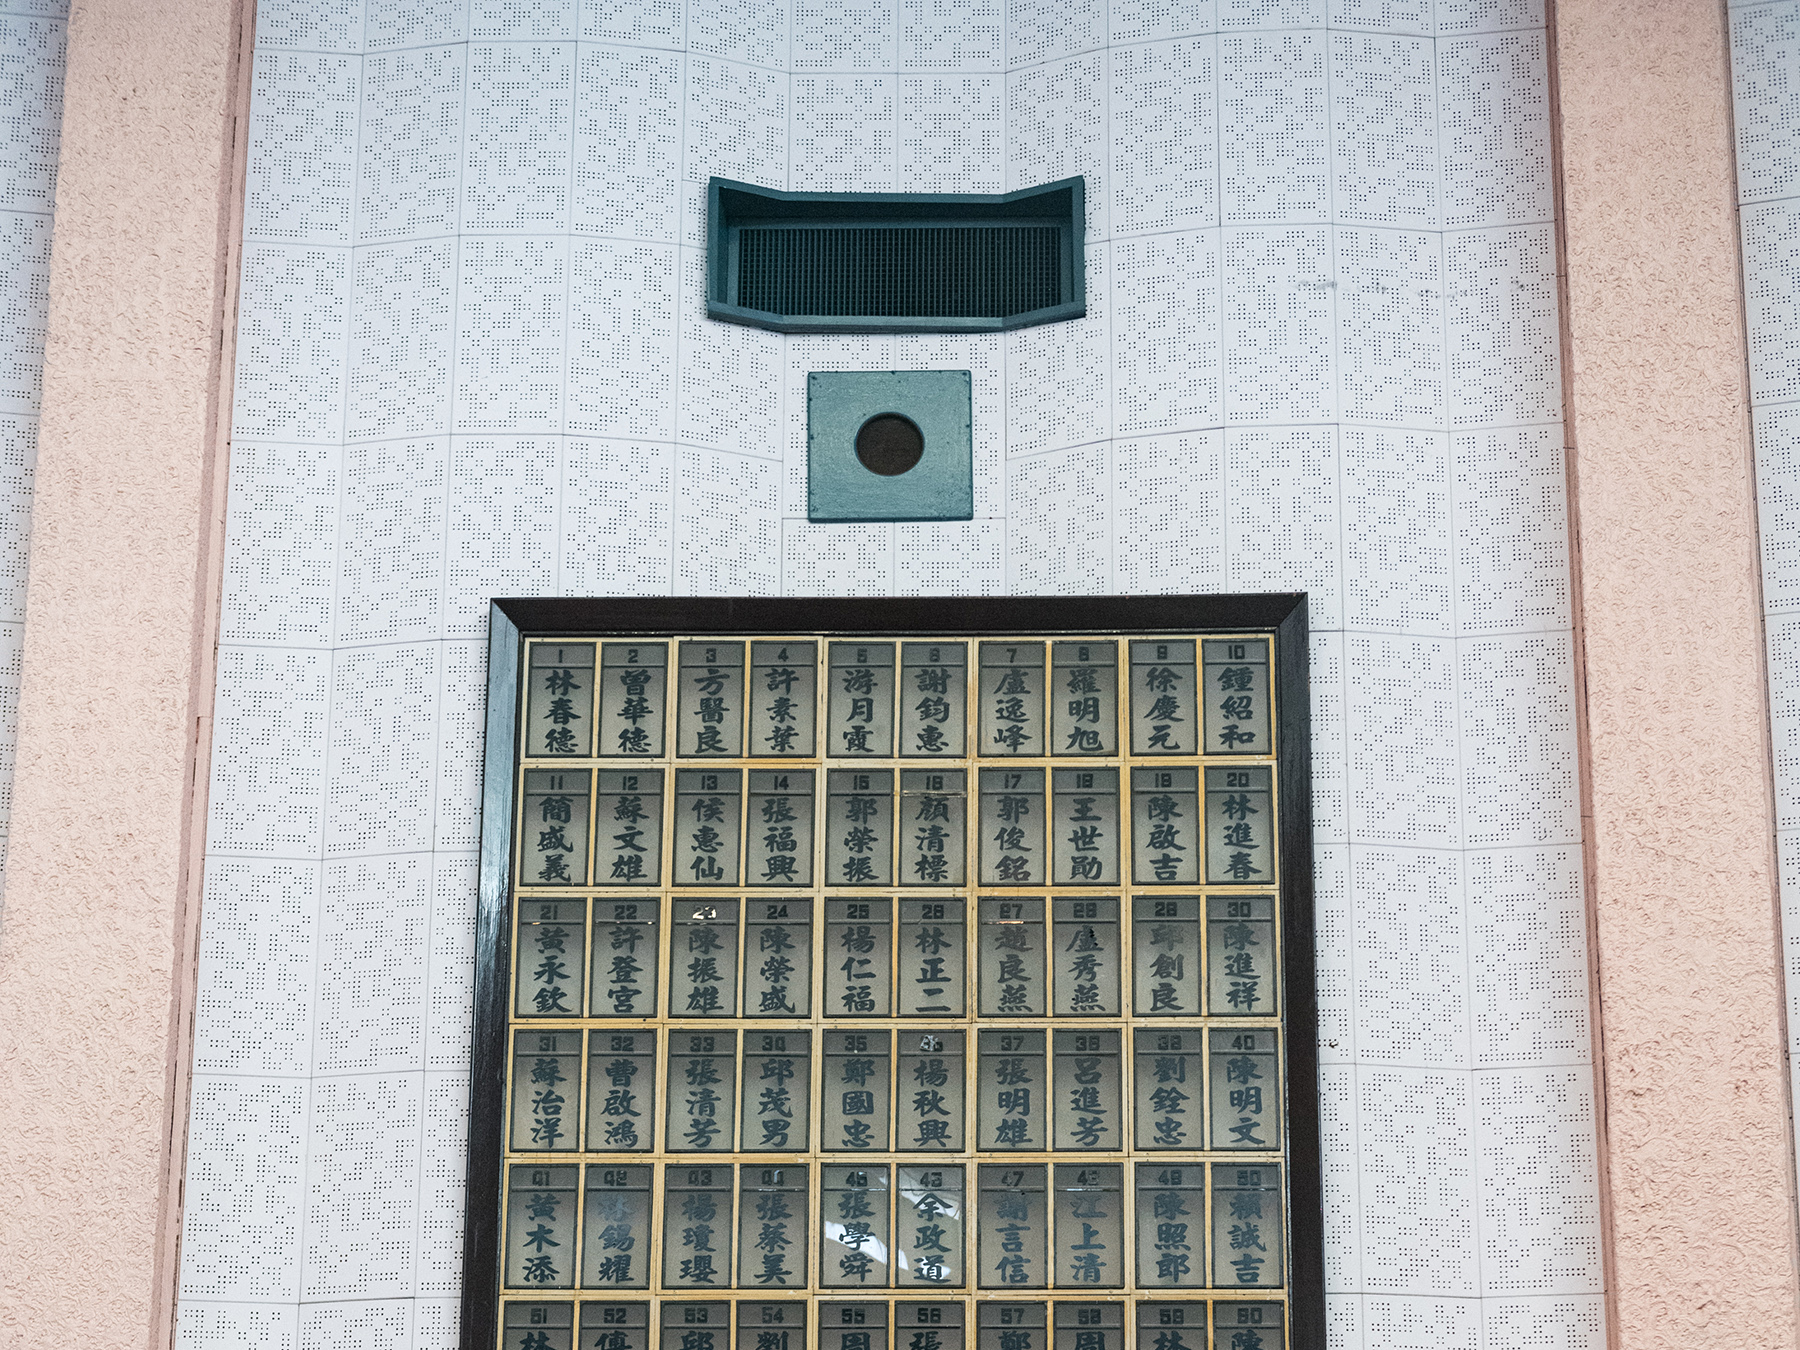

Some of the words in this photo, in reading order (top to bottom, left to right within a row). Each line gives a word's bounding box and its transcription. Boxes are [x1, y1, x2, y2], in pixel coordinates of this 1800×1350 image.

[558, 649, 564, 664] 1
[628, 649, 638, 664] 2
[706, 648, 717, 663] 3
[777, 648, 789, 662] 4
[1006, 648, 1017, 664] 7
[1228, 644, 1246, 660] 10
[544, 669, 581, 753] 林春德
[618, 669, 653, 753] 曾華德
[694, 669, 730, 754] 方醫良
[765, 669, 799, 753] 許素葉
[1144, 667, 1184, 750] 徐慶元
[550, 775, 563, 790] 11
[622, 776, 638, 792] 12
[701, 775, 718, 790] 13
[774, 776, 789, 790] 14
[853, 775, 870, 790] 15
[1004, 774, 1022, 789] 17
[1226, 772, 1250, 788] 20
[611, 797, 648, 883] 蘇文雄
[761, 797, 798, 882] 張福興
[843, 797, 879, 883] 郭榮振
[994, 796, 1032, 882] 郭俊銘
[1223, 796, 1262, 880] 林進春
[540, 905, 558, 920] 21
[614, 904, 637, 920] 22
[766, 904, 788, 920] 24
[846, 904, 870, 920] 25
[999, 903, 1023, 919] 27
[1228, 902, 1251, 918] 30
[533, 926, 571, 1012] 黃永欽
[686, 926, 724, 1015] 陳振雄
[759, 926, 795, 1014] 陳榮盛
[841, 926, 876, 1012] 楊仁福
[916, 925, 951, 1012] 林正二
[1066, 925, 1105, 1012] 盧秀燕
[1225, 925, 1260, 1011] 陳進祥
[538, 1036, 557, 1052] 31
[611, 1036, 634, 1052] 32
[690, 1036, 714, 1052] 33
[844, 1035, 867, 1052] 35
[1001, 1036, 1024, 1051] 37
[1232, 1035, 1255, 1051] 40
[531, 1058, 566, 1149] 蘇治洋
[684, 1058, 721, 1149] 張清芳
[758, 1058, 793, 1149] 邱茂男
[842, 1058, 874, 1149] 鄭國忠
[913, 1057, 952, 1147] 楊秋興
[995, 1057, 1032, 1148] 張明雄
[1071, 1057, 1108, 1147] 呂進芳
[1228, 1057, 1265, 1144] 陳明文
[523, 1193, 560, 1283] 黃木添
[754, 1193, 792, 1284] 張蔡美
[840, 1193, 877, 1282] 張學舜
[913, 1193, 952, 1284] 余政道
[1070, 1193, 1106, 1283] 江上清
[1155, 1193, 1191, 1283] 陳照郎
[530, 1308, 547, 1324] 51
[604, 1308, 627, 1324] 52
[684, 1308, 708, 1324] 53
[762, 1306, 784, 1324] 54
[842, 1308, 865, 1324] 55
[917, 1308, 941, 1324] 56
[1000, 1308, 1024, 1324] 57
